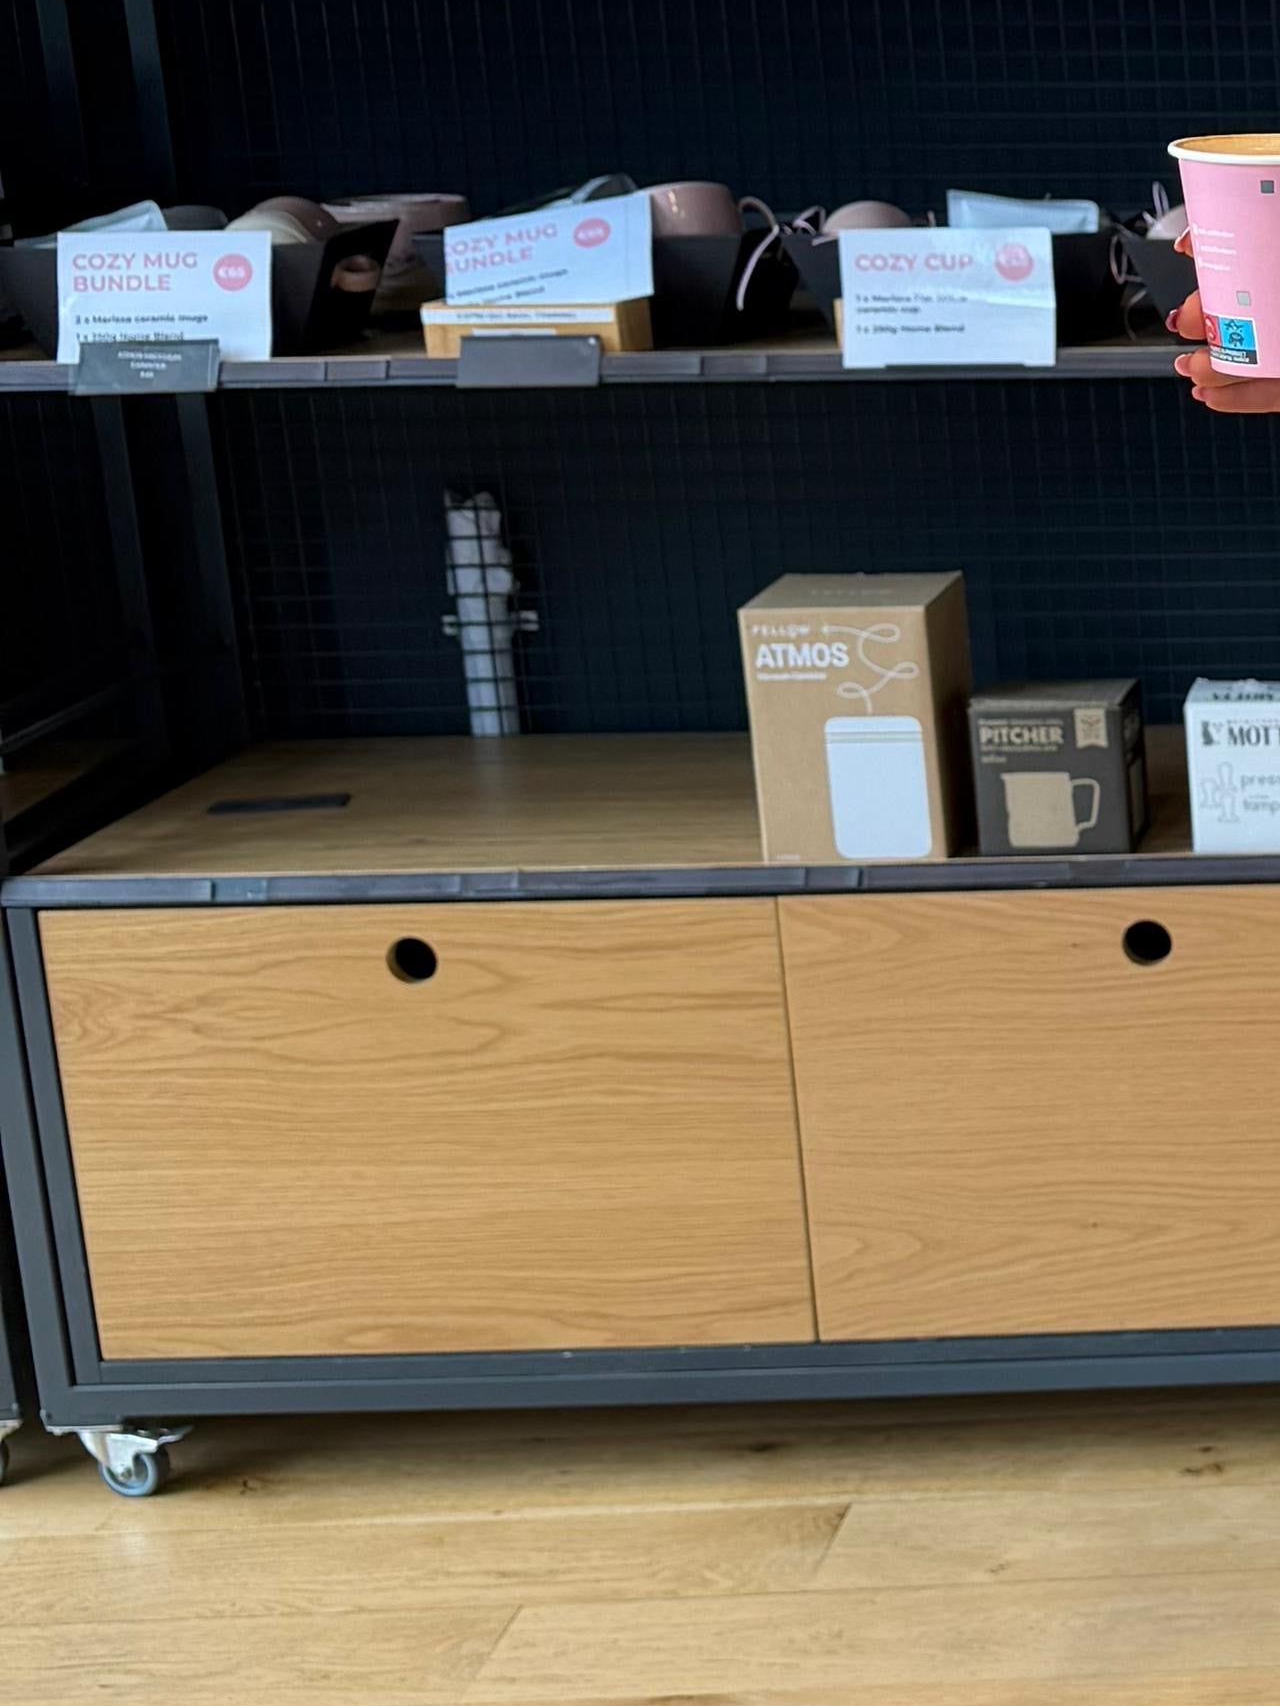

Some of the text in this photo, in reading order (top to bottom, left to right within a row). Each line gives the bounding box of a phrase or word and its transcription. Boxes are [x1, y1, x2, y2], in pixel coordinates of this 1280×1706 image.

[504, 223, 558, 247] MUG
[72, 252, 198, 271] COZY MUG
[854, 252, 974, 272] COZY CUP
[73, 274, 172, 293] BUNDLE
[755, 642, 850, 669] ATMOS
[979, 726, 1064, 744] PITCHER
